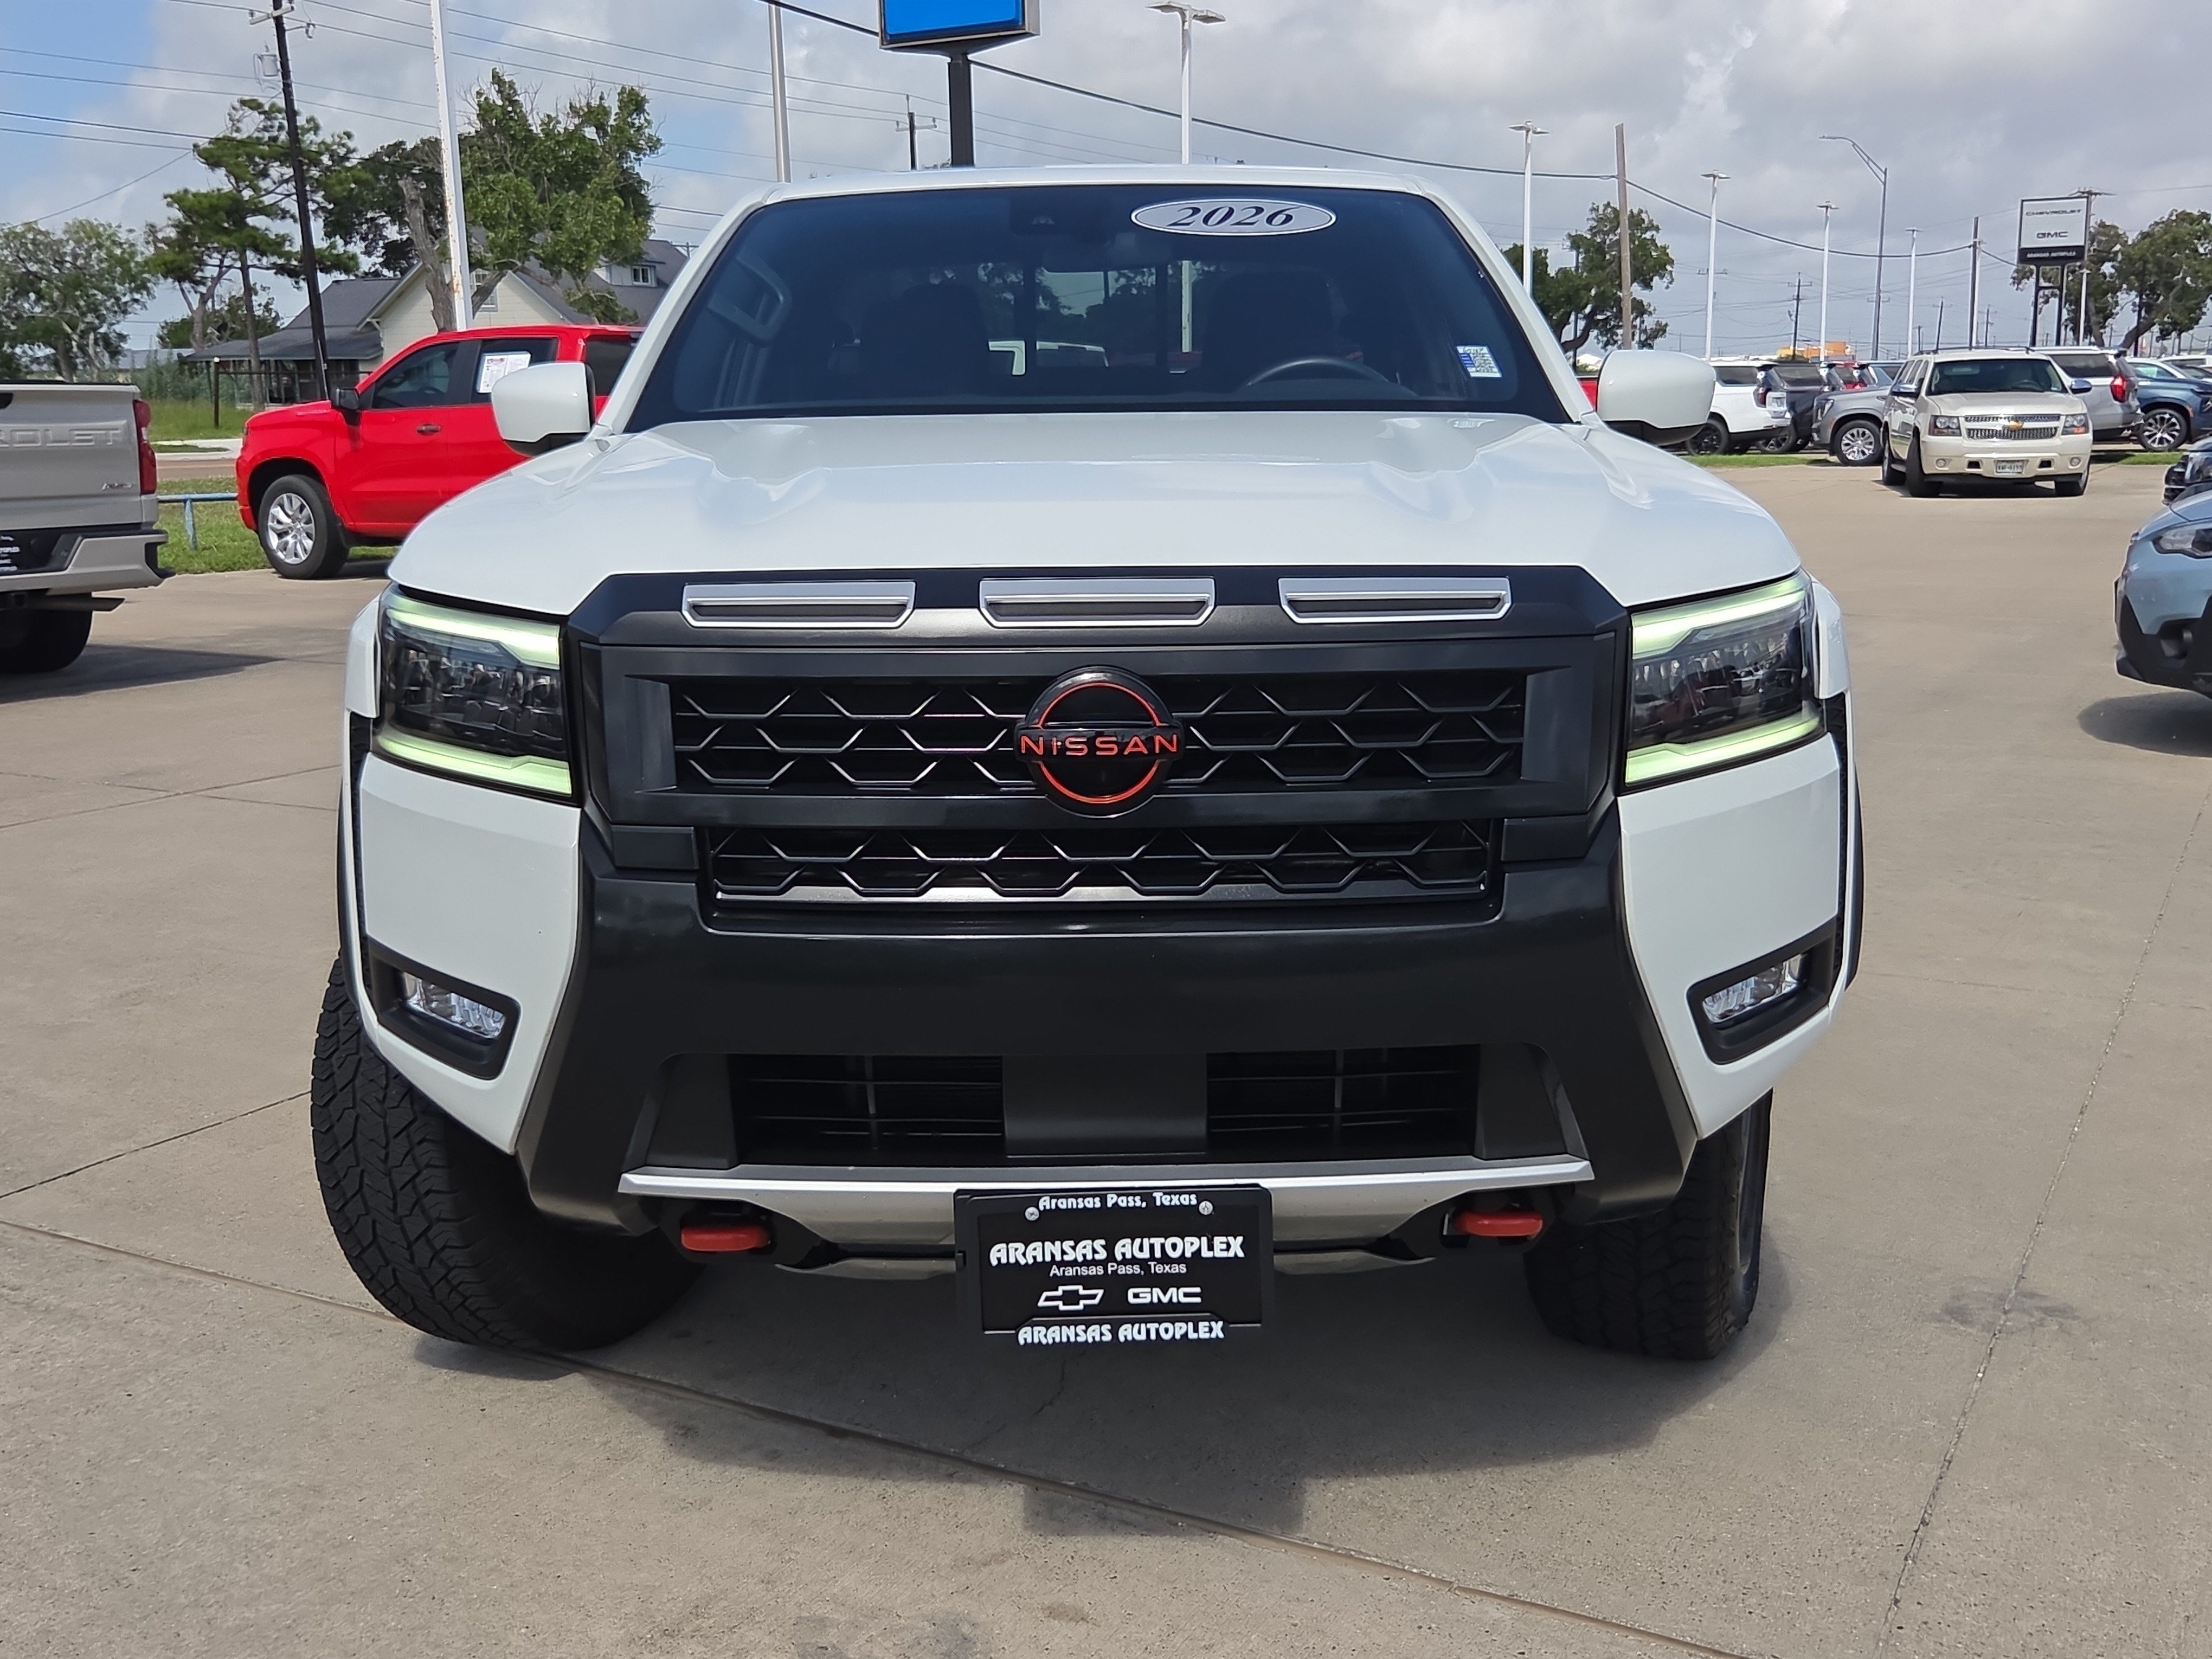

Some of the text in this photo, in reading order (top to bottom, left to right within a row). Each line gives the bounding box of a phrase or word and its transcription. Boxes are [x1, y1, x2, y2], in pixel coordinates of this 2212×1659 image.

[1166, 205, 1301, 227] 2026
[1020, 734, 1177, 756] NISSAN
[1039, 1192, 1198, 1211] Aransas Pass, Texas
[989, 1236, 1245, 1267] ARANSAS AUTOPLEX
[1050, 1261, 1187, 1277] Aransas Pass, Texas
[1127, 1287, 1202, 1304] GMC
[1018, 1321, 1225, 1346] ARANSAS AUTOPLEX
